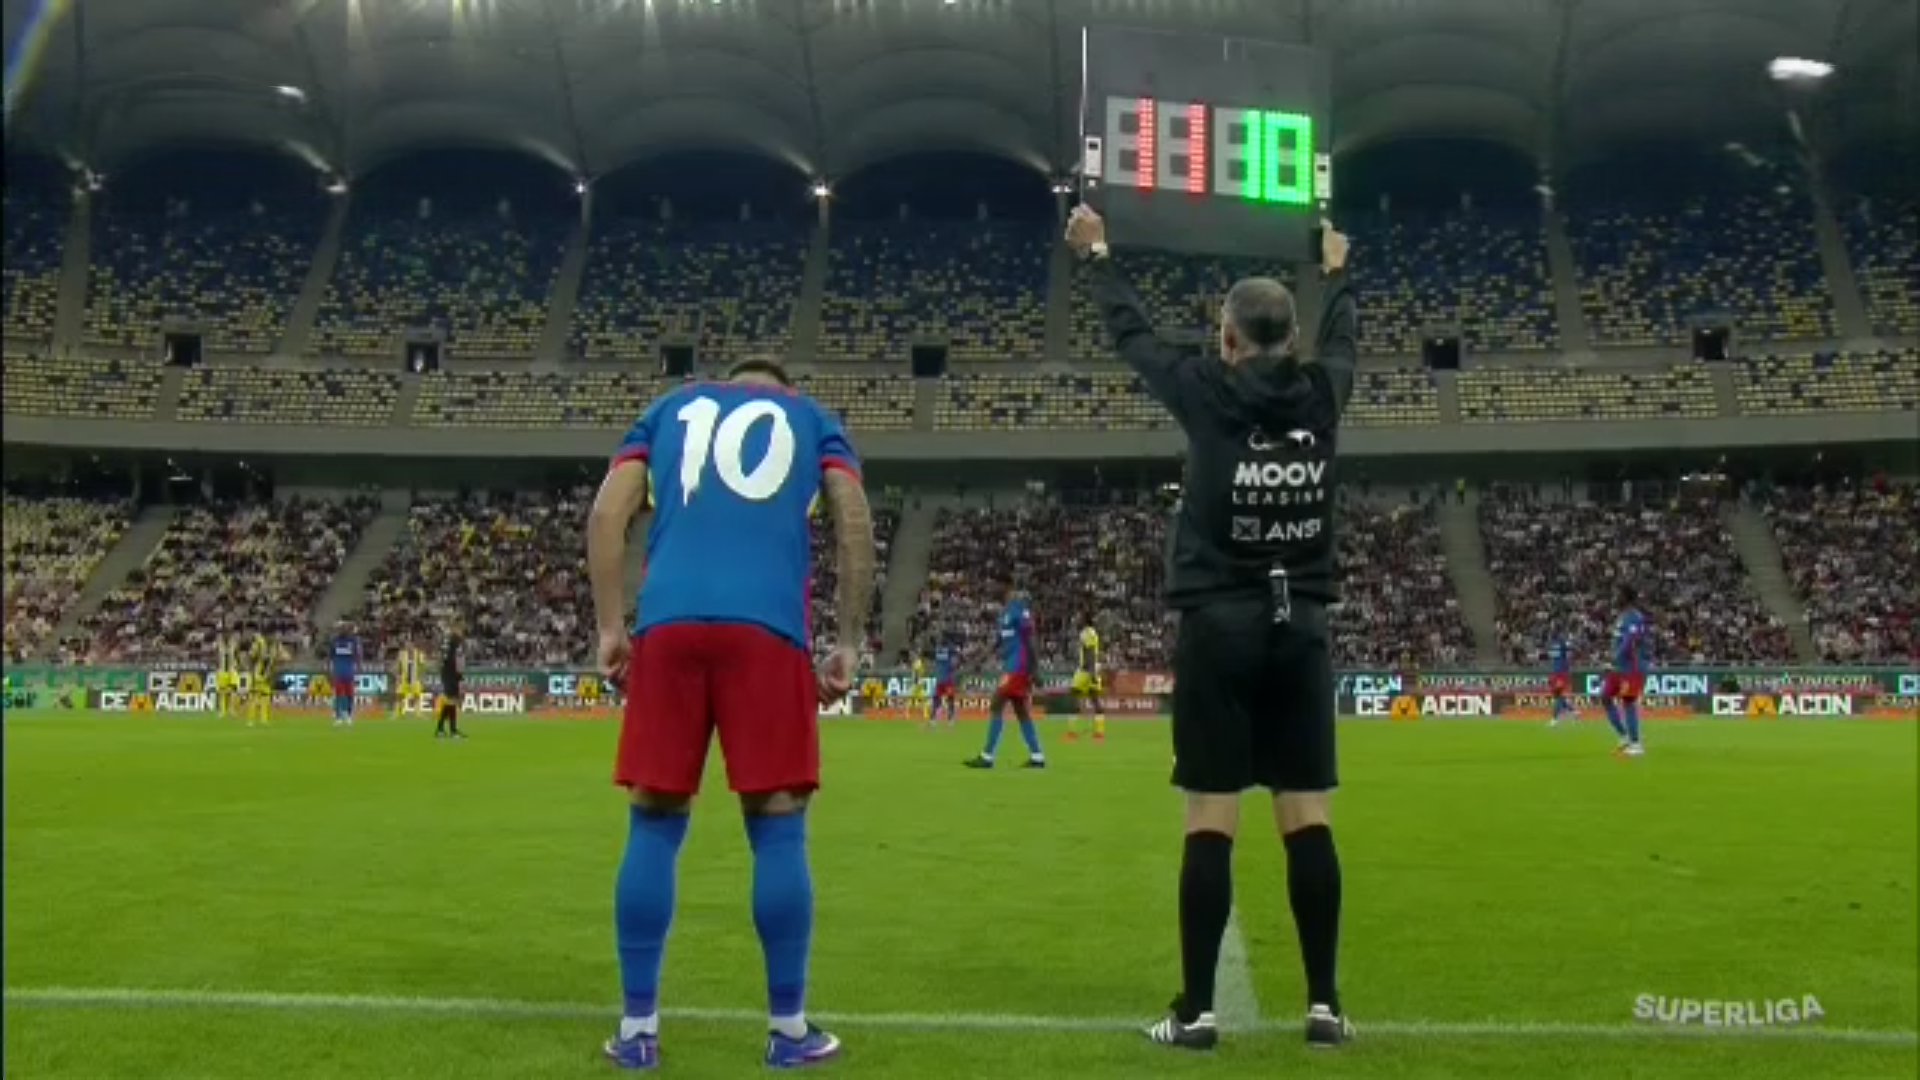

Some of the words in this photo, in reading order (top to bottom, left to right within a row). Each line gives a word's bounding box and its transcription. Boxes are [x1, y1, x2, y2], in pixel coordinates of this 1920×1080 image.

[1135, 97, 1206, 194] 11
[1240, 108, 1312, 205] 10
[677, 396, 795, 506] 10
[1233, 460, 1327, 487] MOOV
[101, 692, 217, 715] CEMACON
[1355, 694, 1492, 720] CEMACON
[1712, 693, 1852, 720] CEMACON
